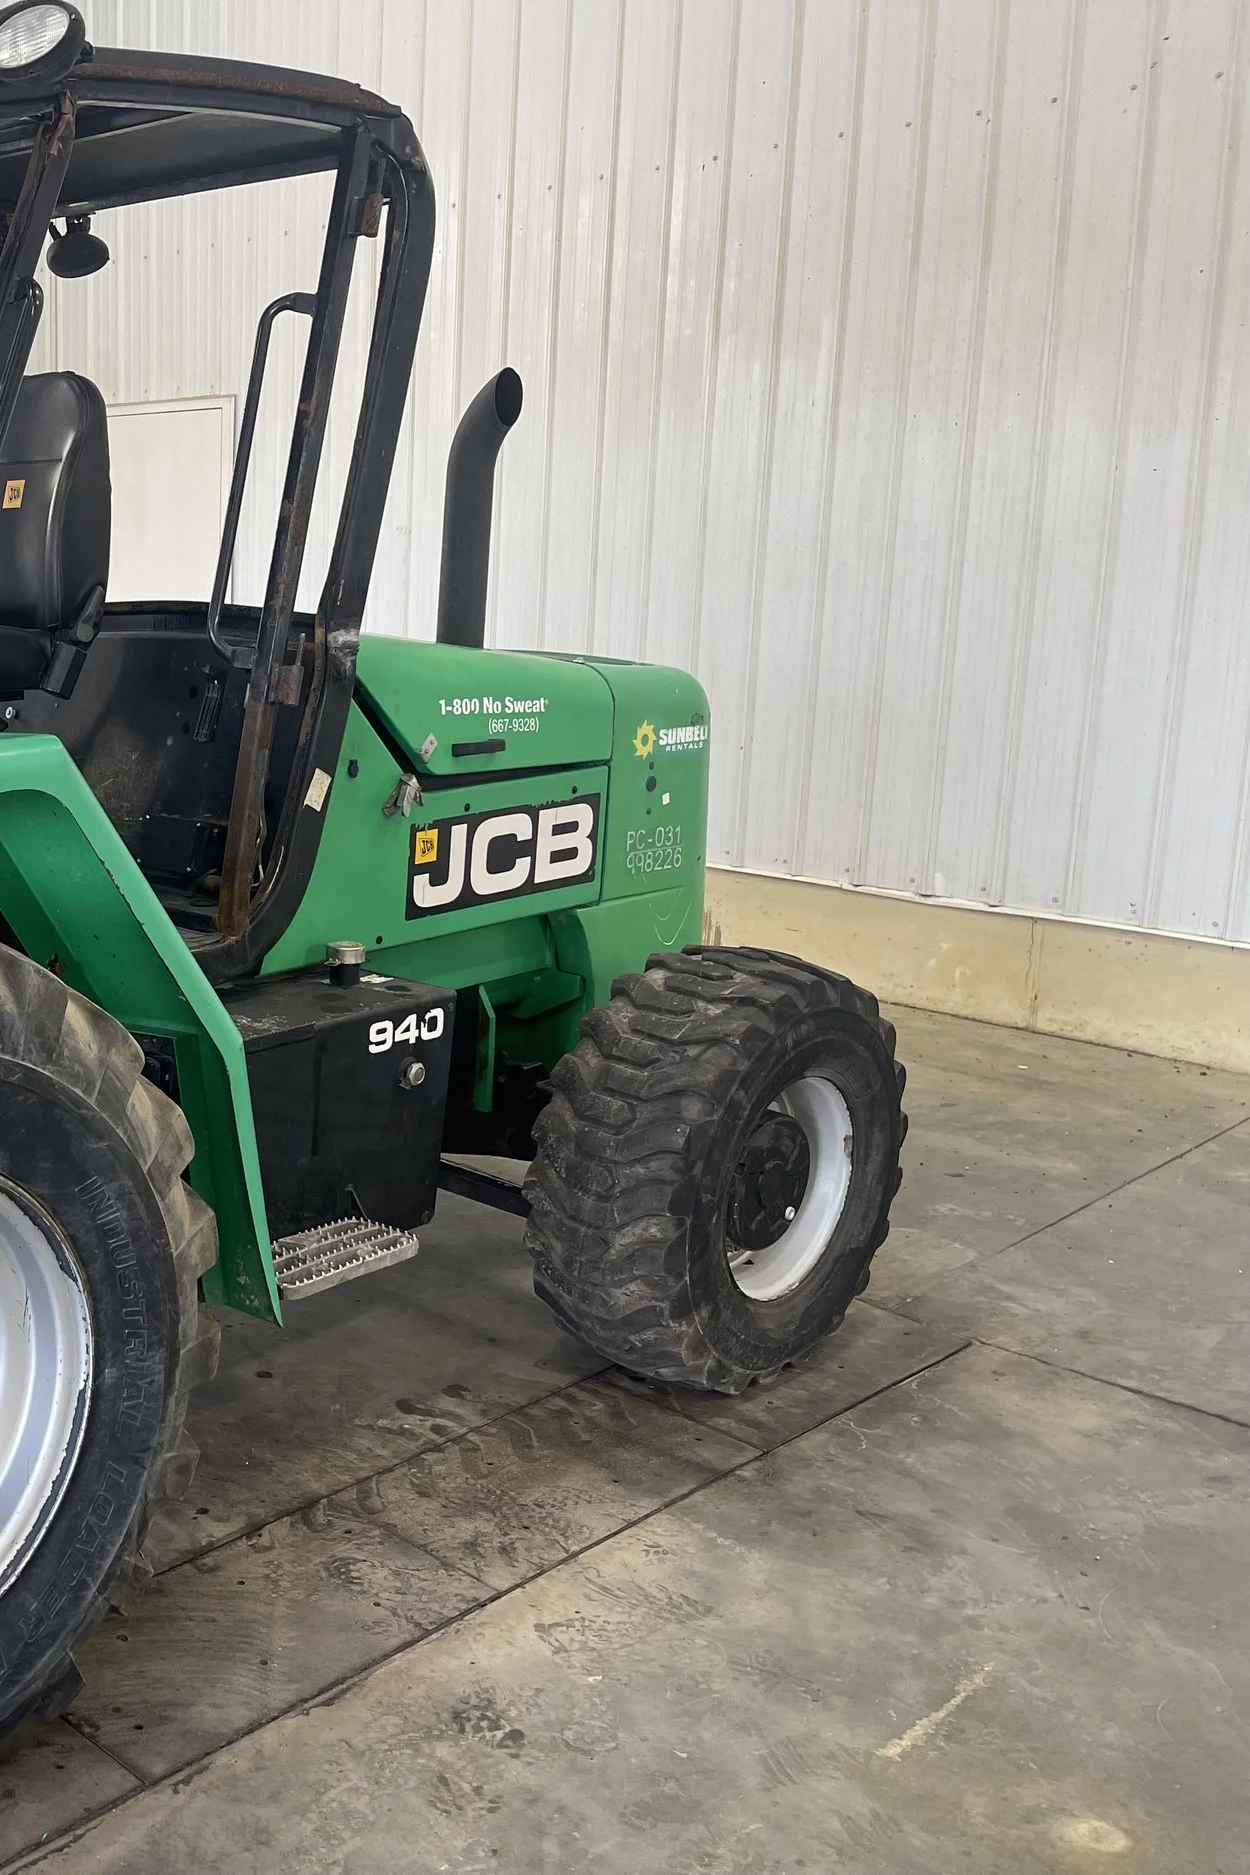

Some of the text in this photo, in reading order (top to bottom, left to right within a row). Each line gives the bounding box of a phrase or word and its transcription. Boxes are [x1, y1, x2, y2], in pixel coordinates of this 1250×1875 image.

[438, 698, 480, 716] 1-800
[483, 696, 502, 714] No
[488, 716, 540, 735] (667-9328)
[665, 741, 704, 752] RENTALS
[626, 825, 681, 852] PC-031
[413, 802, 594, 908] JCB
[626, 847, 683, 875] 998226
[368, 1007, 444, 1054] 940
[76, 1176, 150, 1437] INDUSTRIAL
[19, 1458, 128, 1643] LOADER
